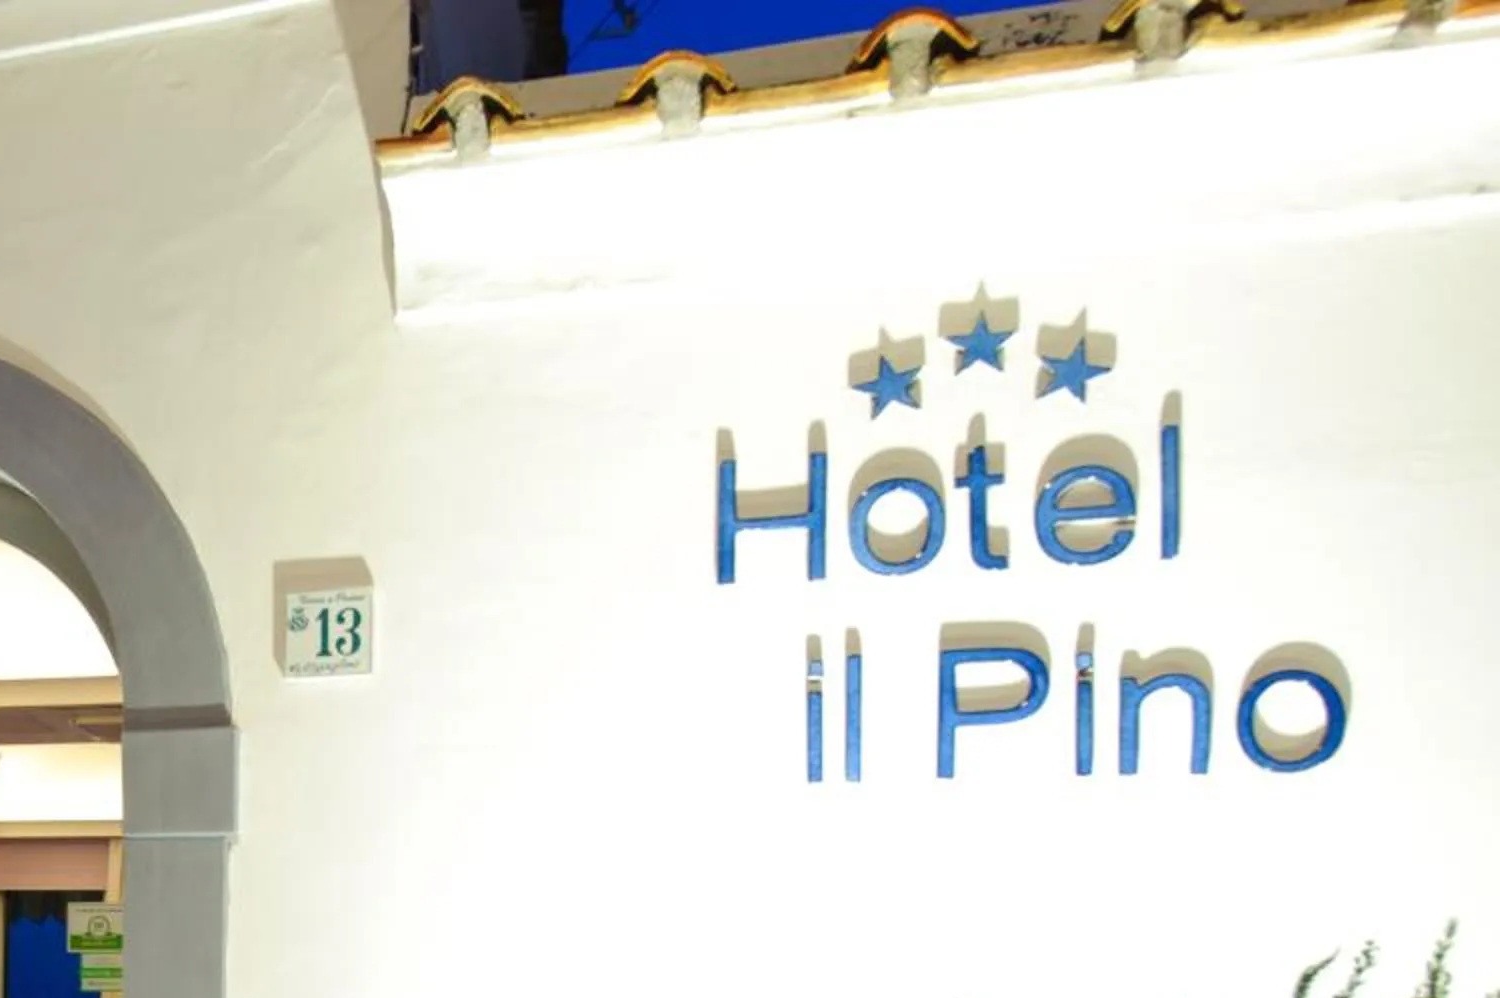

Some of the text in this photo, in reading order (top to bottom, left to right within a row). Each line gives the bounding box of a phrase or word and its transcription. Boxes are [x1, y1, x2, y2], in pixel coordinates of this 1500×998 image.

[716, 424, 1182, 585] Hotel
[315, 606, 362, 657] 13
[806, 646, 1347, 783] il Pino
